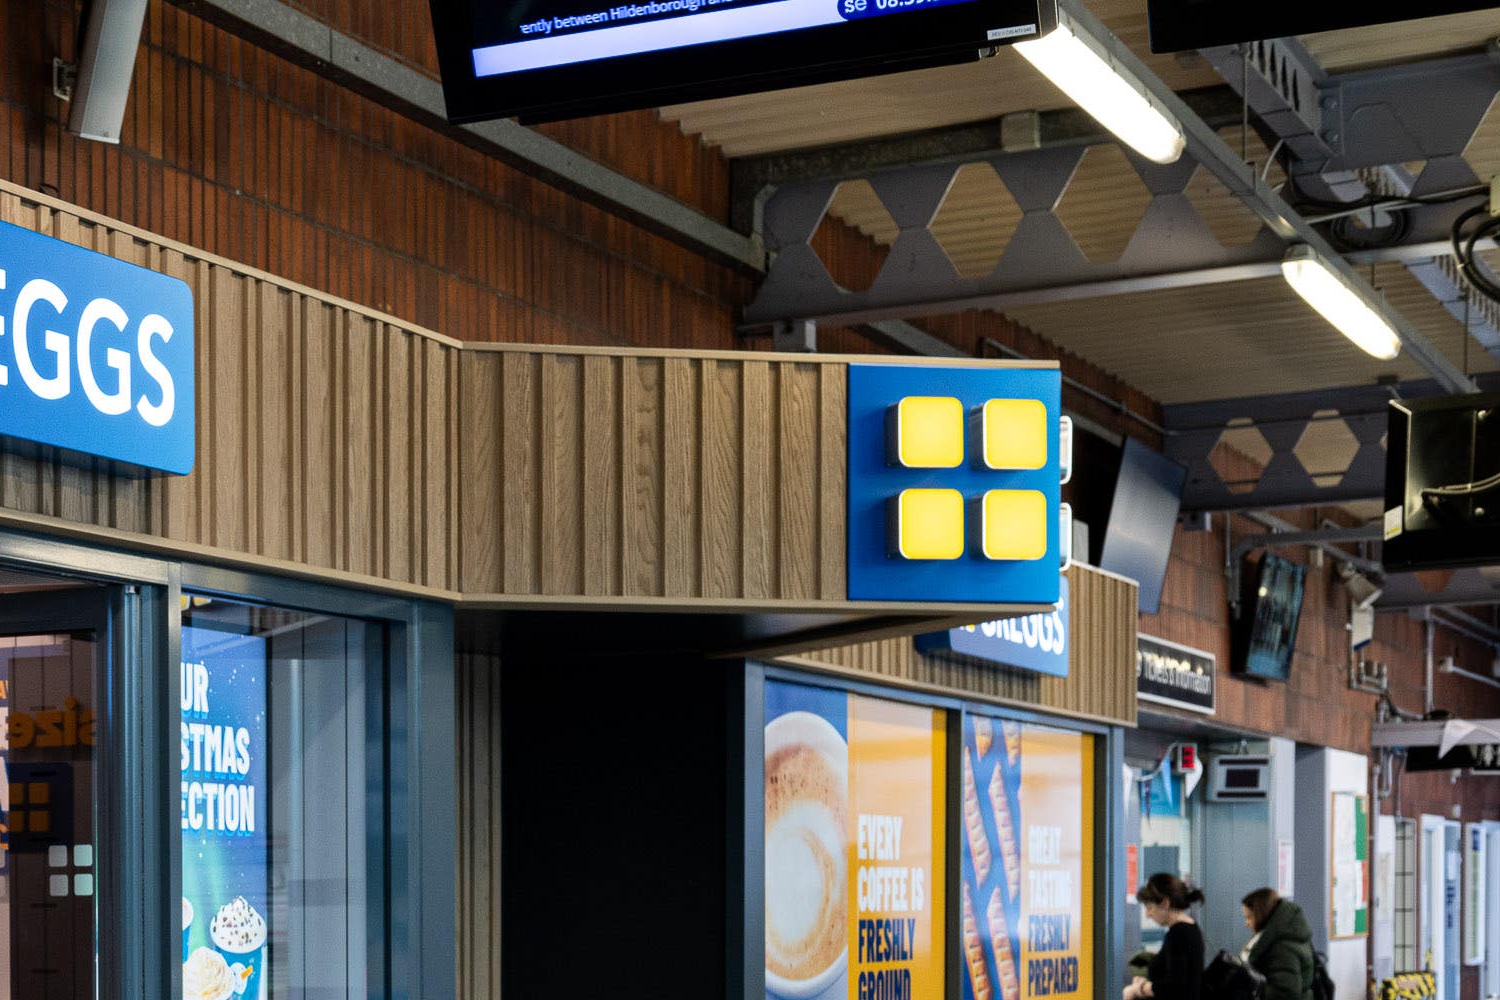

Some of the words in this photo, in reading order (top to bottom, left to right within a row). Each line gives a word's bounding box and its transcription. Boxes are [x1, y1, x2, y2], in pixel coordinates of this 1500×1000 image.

[554, 12, 608, 28] between
[858, 813, 902, 860] EVERY
[857, 866, 908, 912] COFFEE
[911, 867, 924, 910] IS
[858, 918, 915, 964] FRESHLY
[1028, 913, 1071, 952] FRESHLY
[1028, 956, 1079, 997] PREPARED
